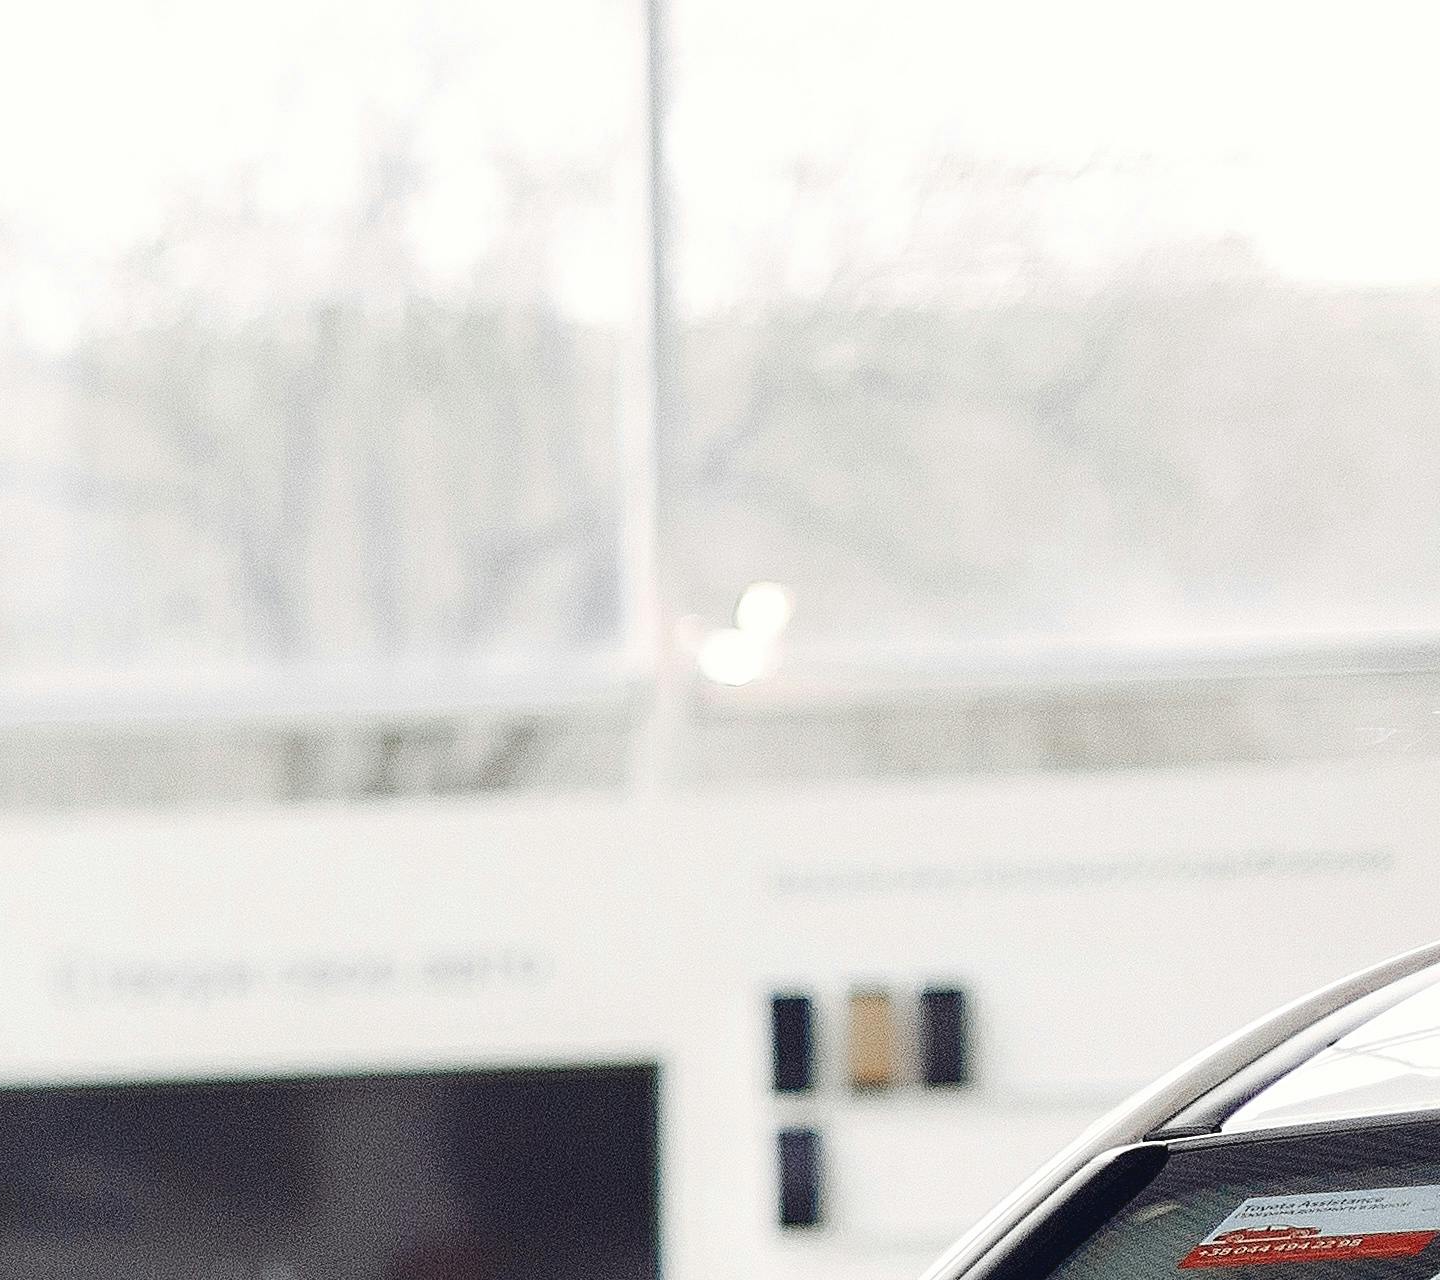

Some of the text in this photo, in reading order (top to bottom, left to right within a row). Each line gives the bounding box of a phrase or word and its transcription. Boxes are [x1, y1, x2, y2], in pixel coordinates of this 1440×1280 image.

[1243, 1196, 1384, 1213] Toyota Assistance
[1199, 1248, 1231, 1257] +38
[1233, 1245, 1271, 1255] 044
[1273, 1242, 1309, 1251] 494
[1311, 1240, 1336, 1249] 22
[1337, 1238, 1364, 1247] 98
